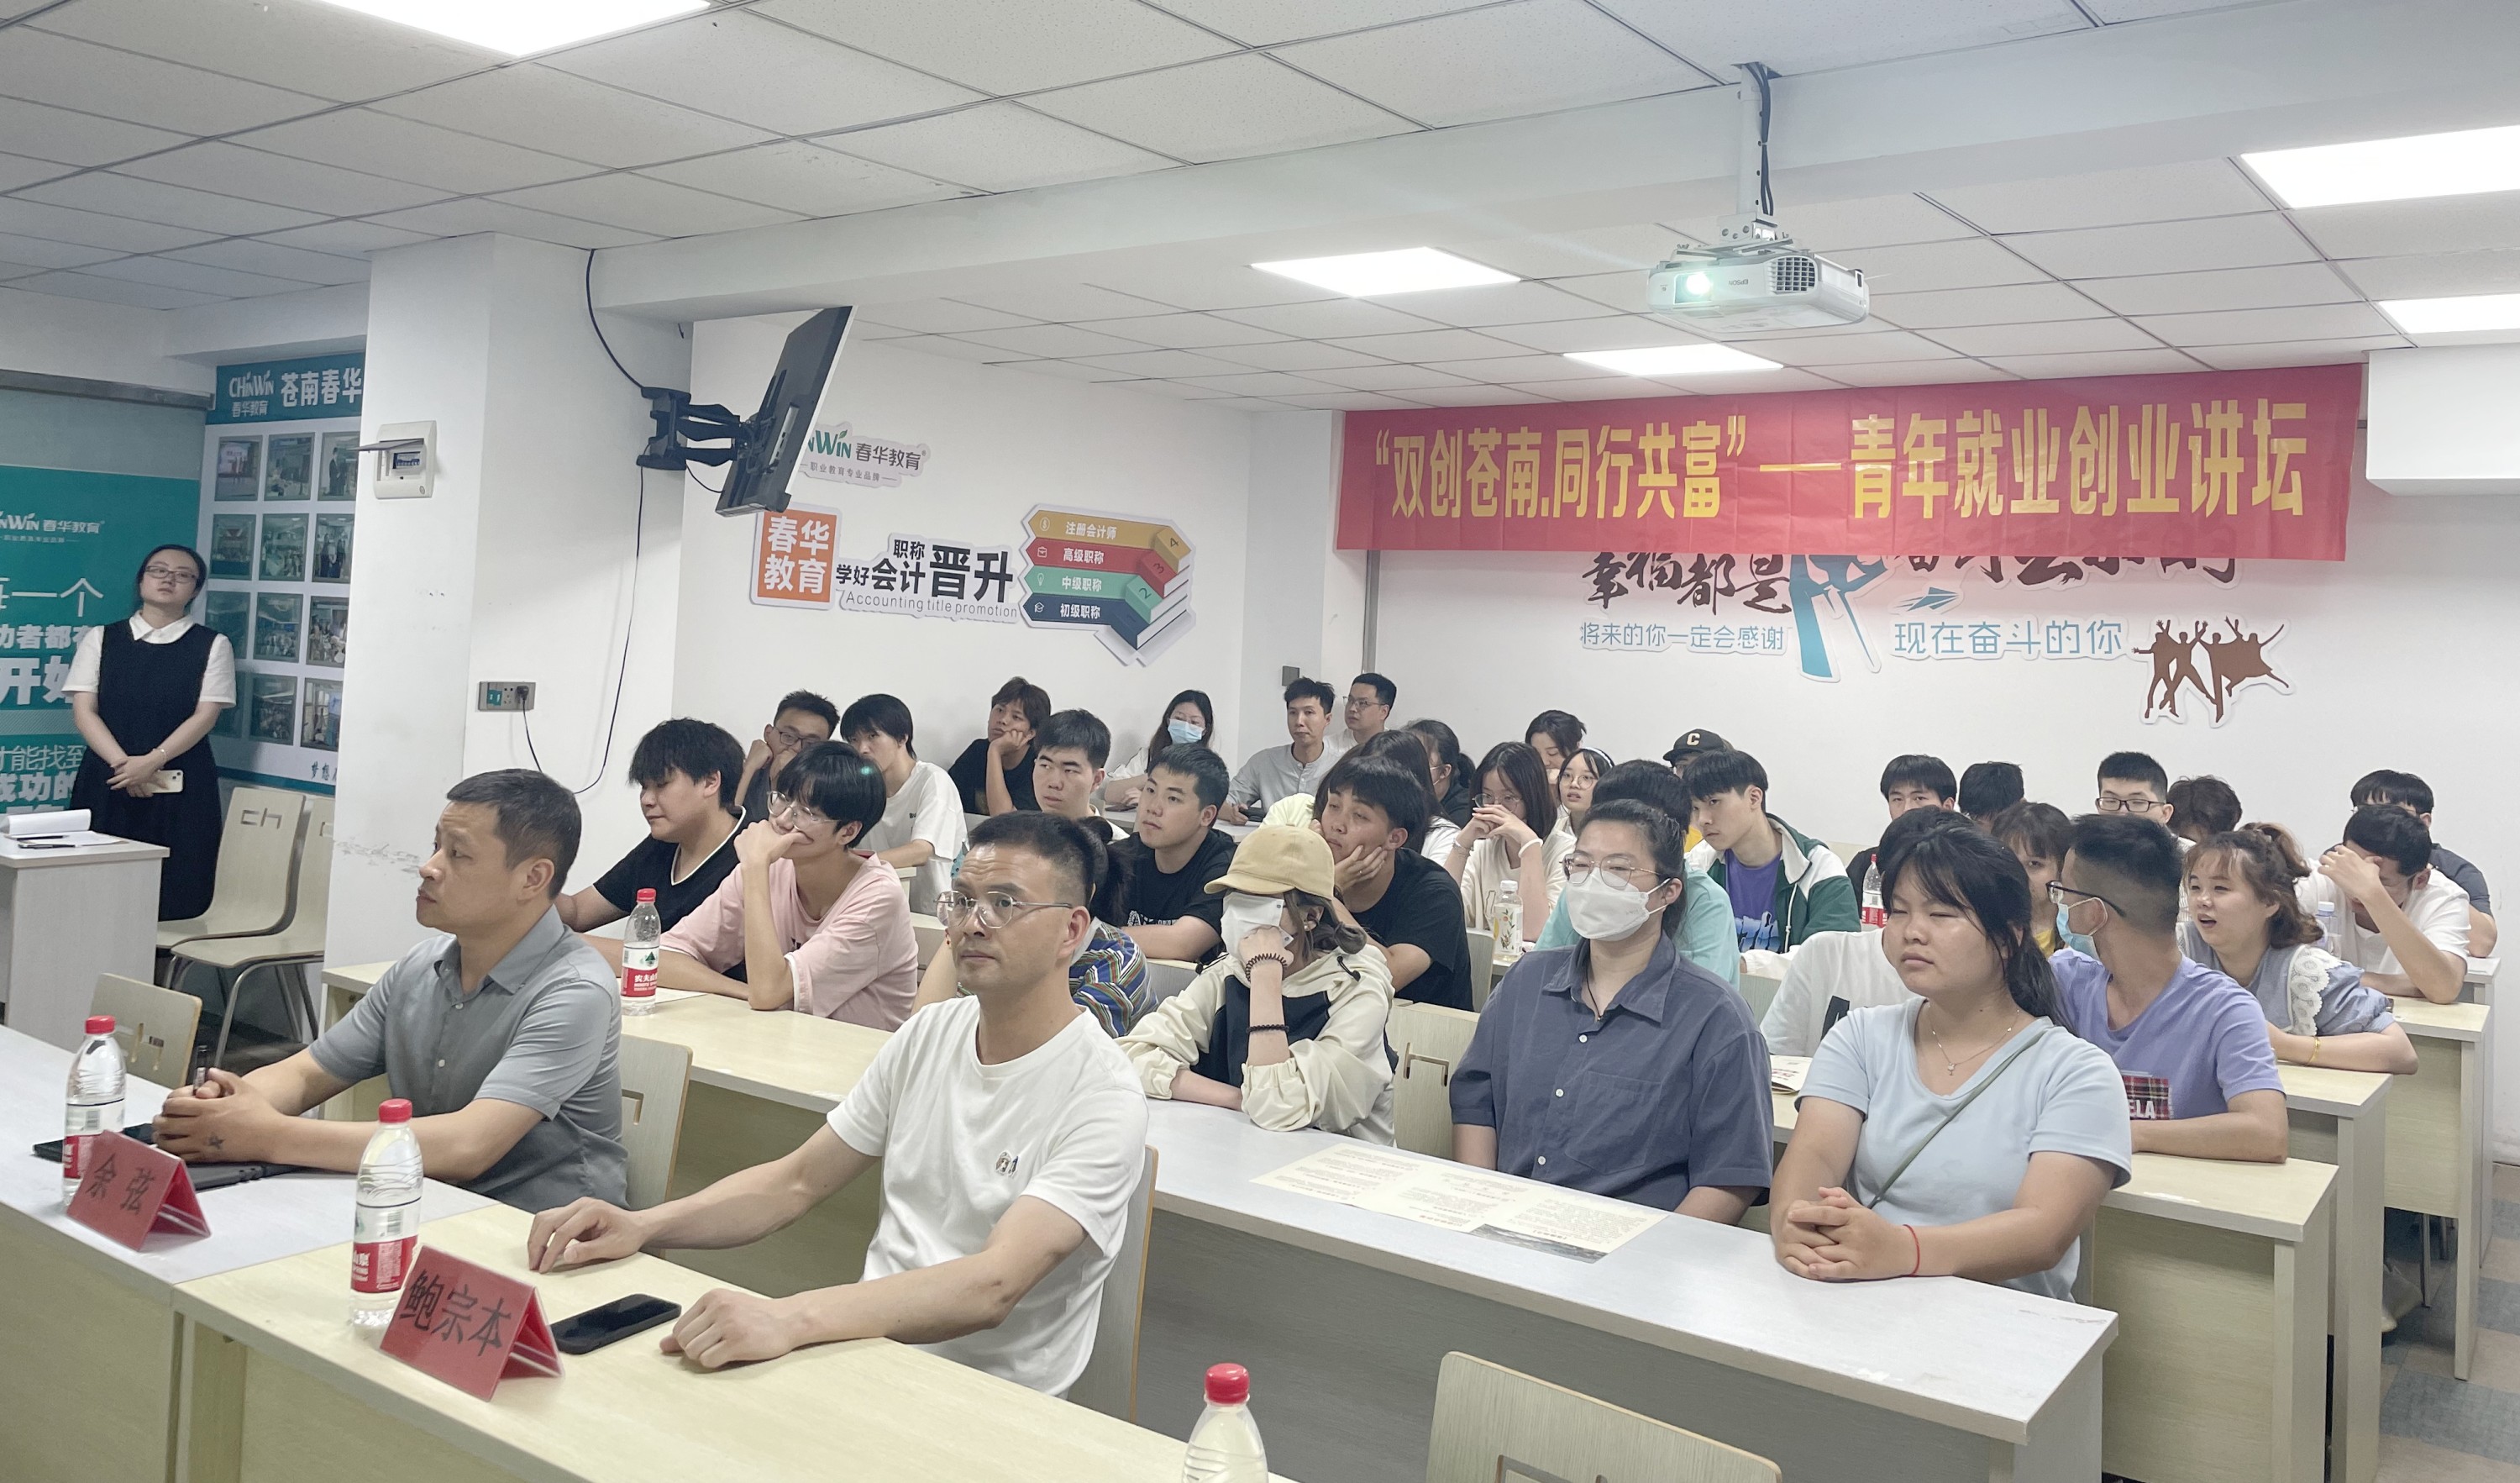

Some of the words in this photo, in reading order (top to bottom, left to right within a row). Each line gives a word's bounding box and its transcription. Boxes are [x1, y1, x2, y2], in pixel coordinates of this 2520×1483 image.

[281, 367, 362, 408] 苍南春华
[232, 400, 268, 418] 春华教育
[855, 442, 921, 471] 春华教育
[810, 461, 880, 481] 职业教育专业品牌
[768, 515, 830, 556] 春华
[1064, 521, 1118, 540] 注册会计师
[892, 539, 926, 561] 职称
[1169, 537, 1179, 548] 4
[1063, 547, 1105, 565] 高级职称
[764, 554, 828, 594] 教育
[1152, 562, 1165, 576] 3
[1061, 576, 1103, 592] 中级职称
[1138, 587, 1152, 600] 2
[0, 577, 104, 618] 一个
[845, 591, 924, 613] Accounting
[927, 599, 952, 613] title
[955, 600, 1018, 618] promotion
[1059, 602, 1101, 620] 初级职称
[1579, 622, 1784, 650] 将来的你一定会感谢
[1894, 619, 2123, 655] 现在奋斗的你
[1687, 733, 1700, 746] C
[399, 1269, 512, 1357] 鲍宗本
